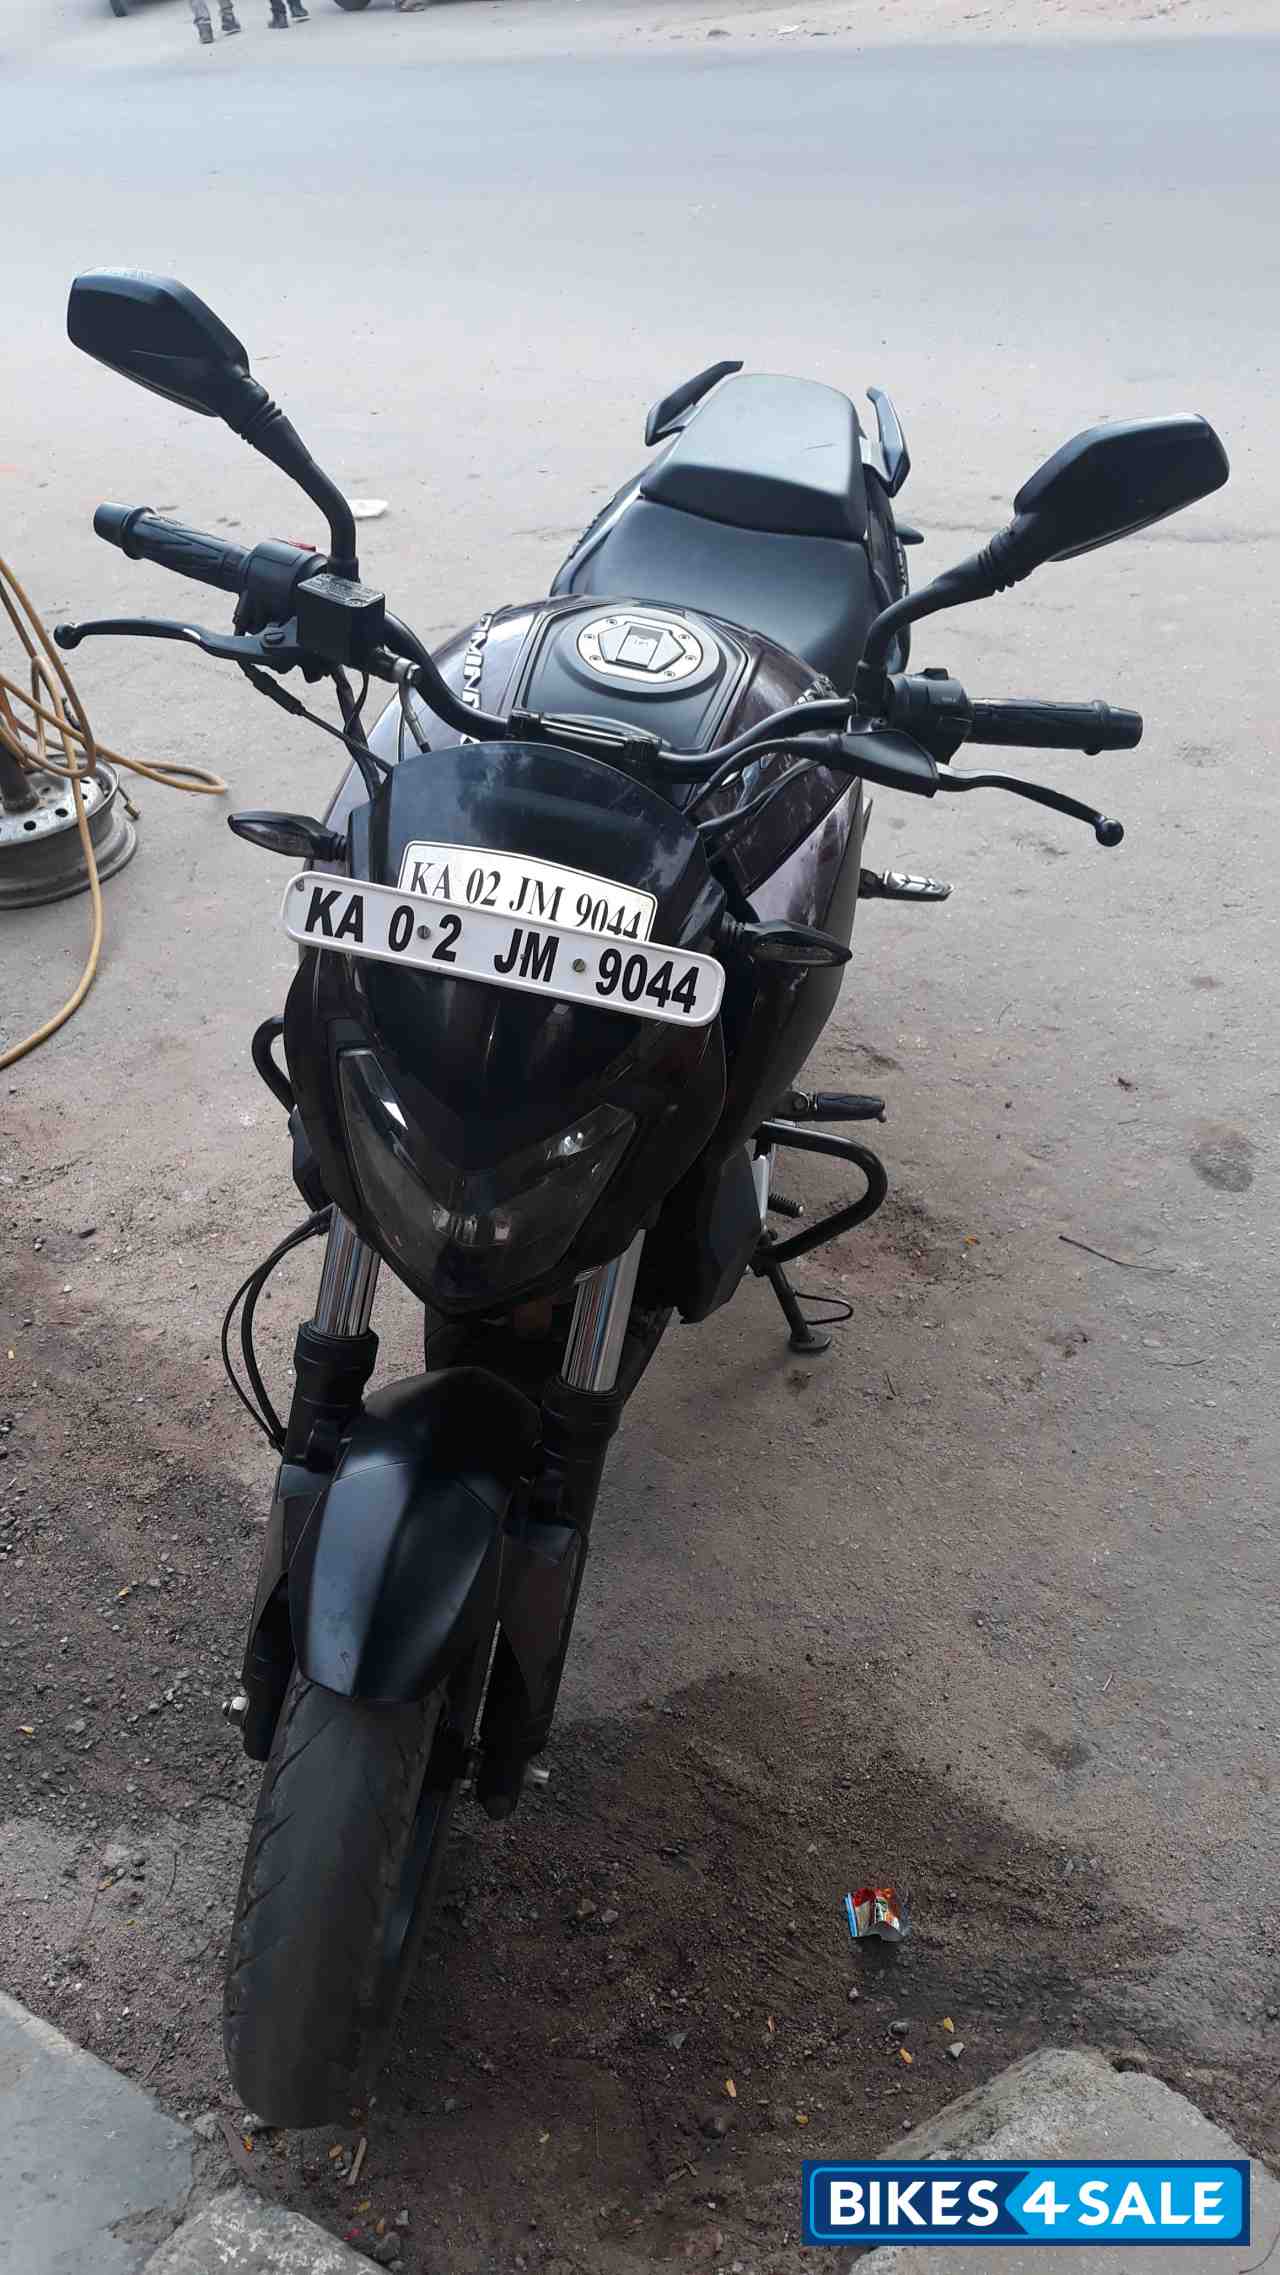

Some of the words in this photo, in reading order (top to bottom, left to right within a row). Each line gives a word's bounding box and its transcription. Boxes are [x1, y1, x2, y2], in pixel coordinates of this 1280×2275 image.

[304, 886, 366, 943] KA
[494, 929, 560, 983] JM
[596, 948, 701, 1014] 9044
[411, 862, 451, 900] KA
[466, 868, 502, 906] 02
[509, 876, 566, 922] JM
[574, 893, 642, 940] 9044
